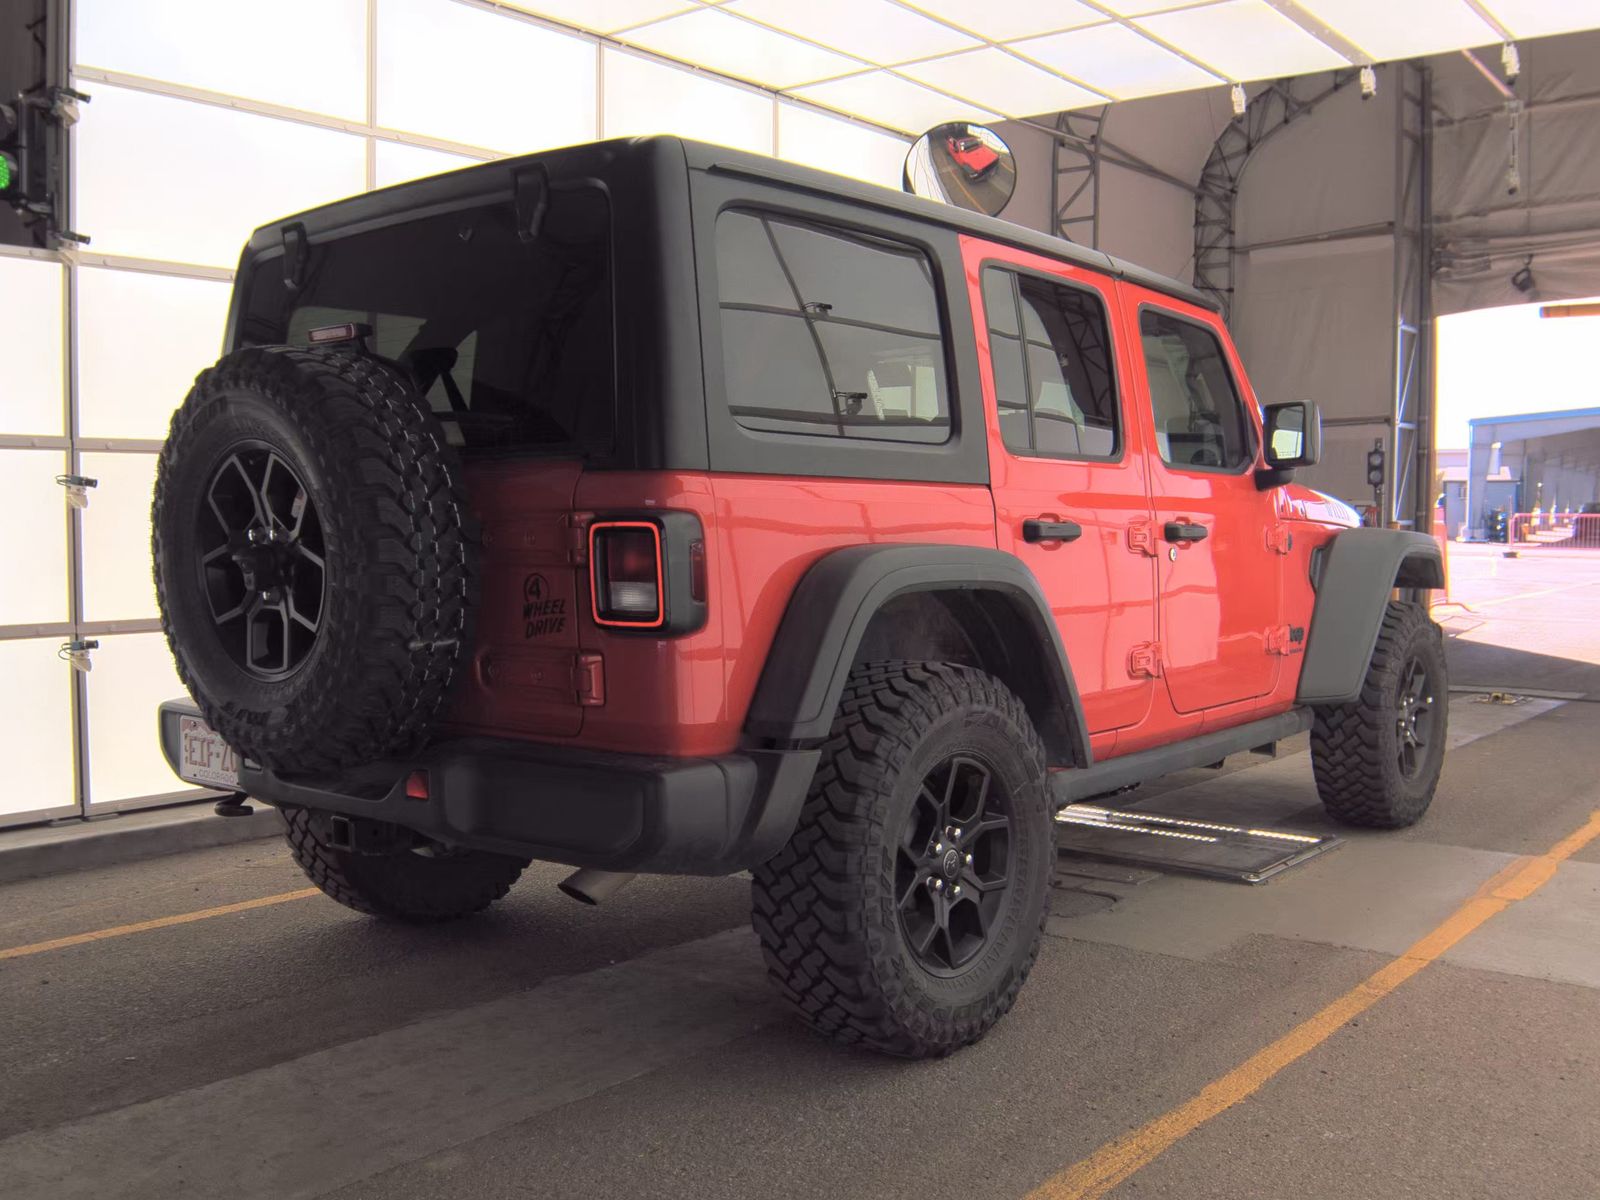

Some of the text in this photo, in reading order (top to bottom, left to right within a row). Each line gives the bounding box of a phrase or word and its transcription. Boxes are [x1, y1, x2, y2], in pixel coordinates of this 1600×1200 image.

[528, 577, 541, 600] 4
[522, 598, 567, 620] WHEEL
[525, 617, 566, 640] DRIVE
